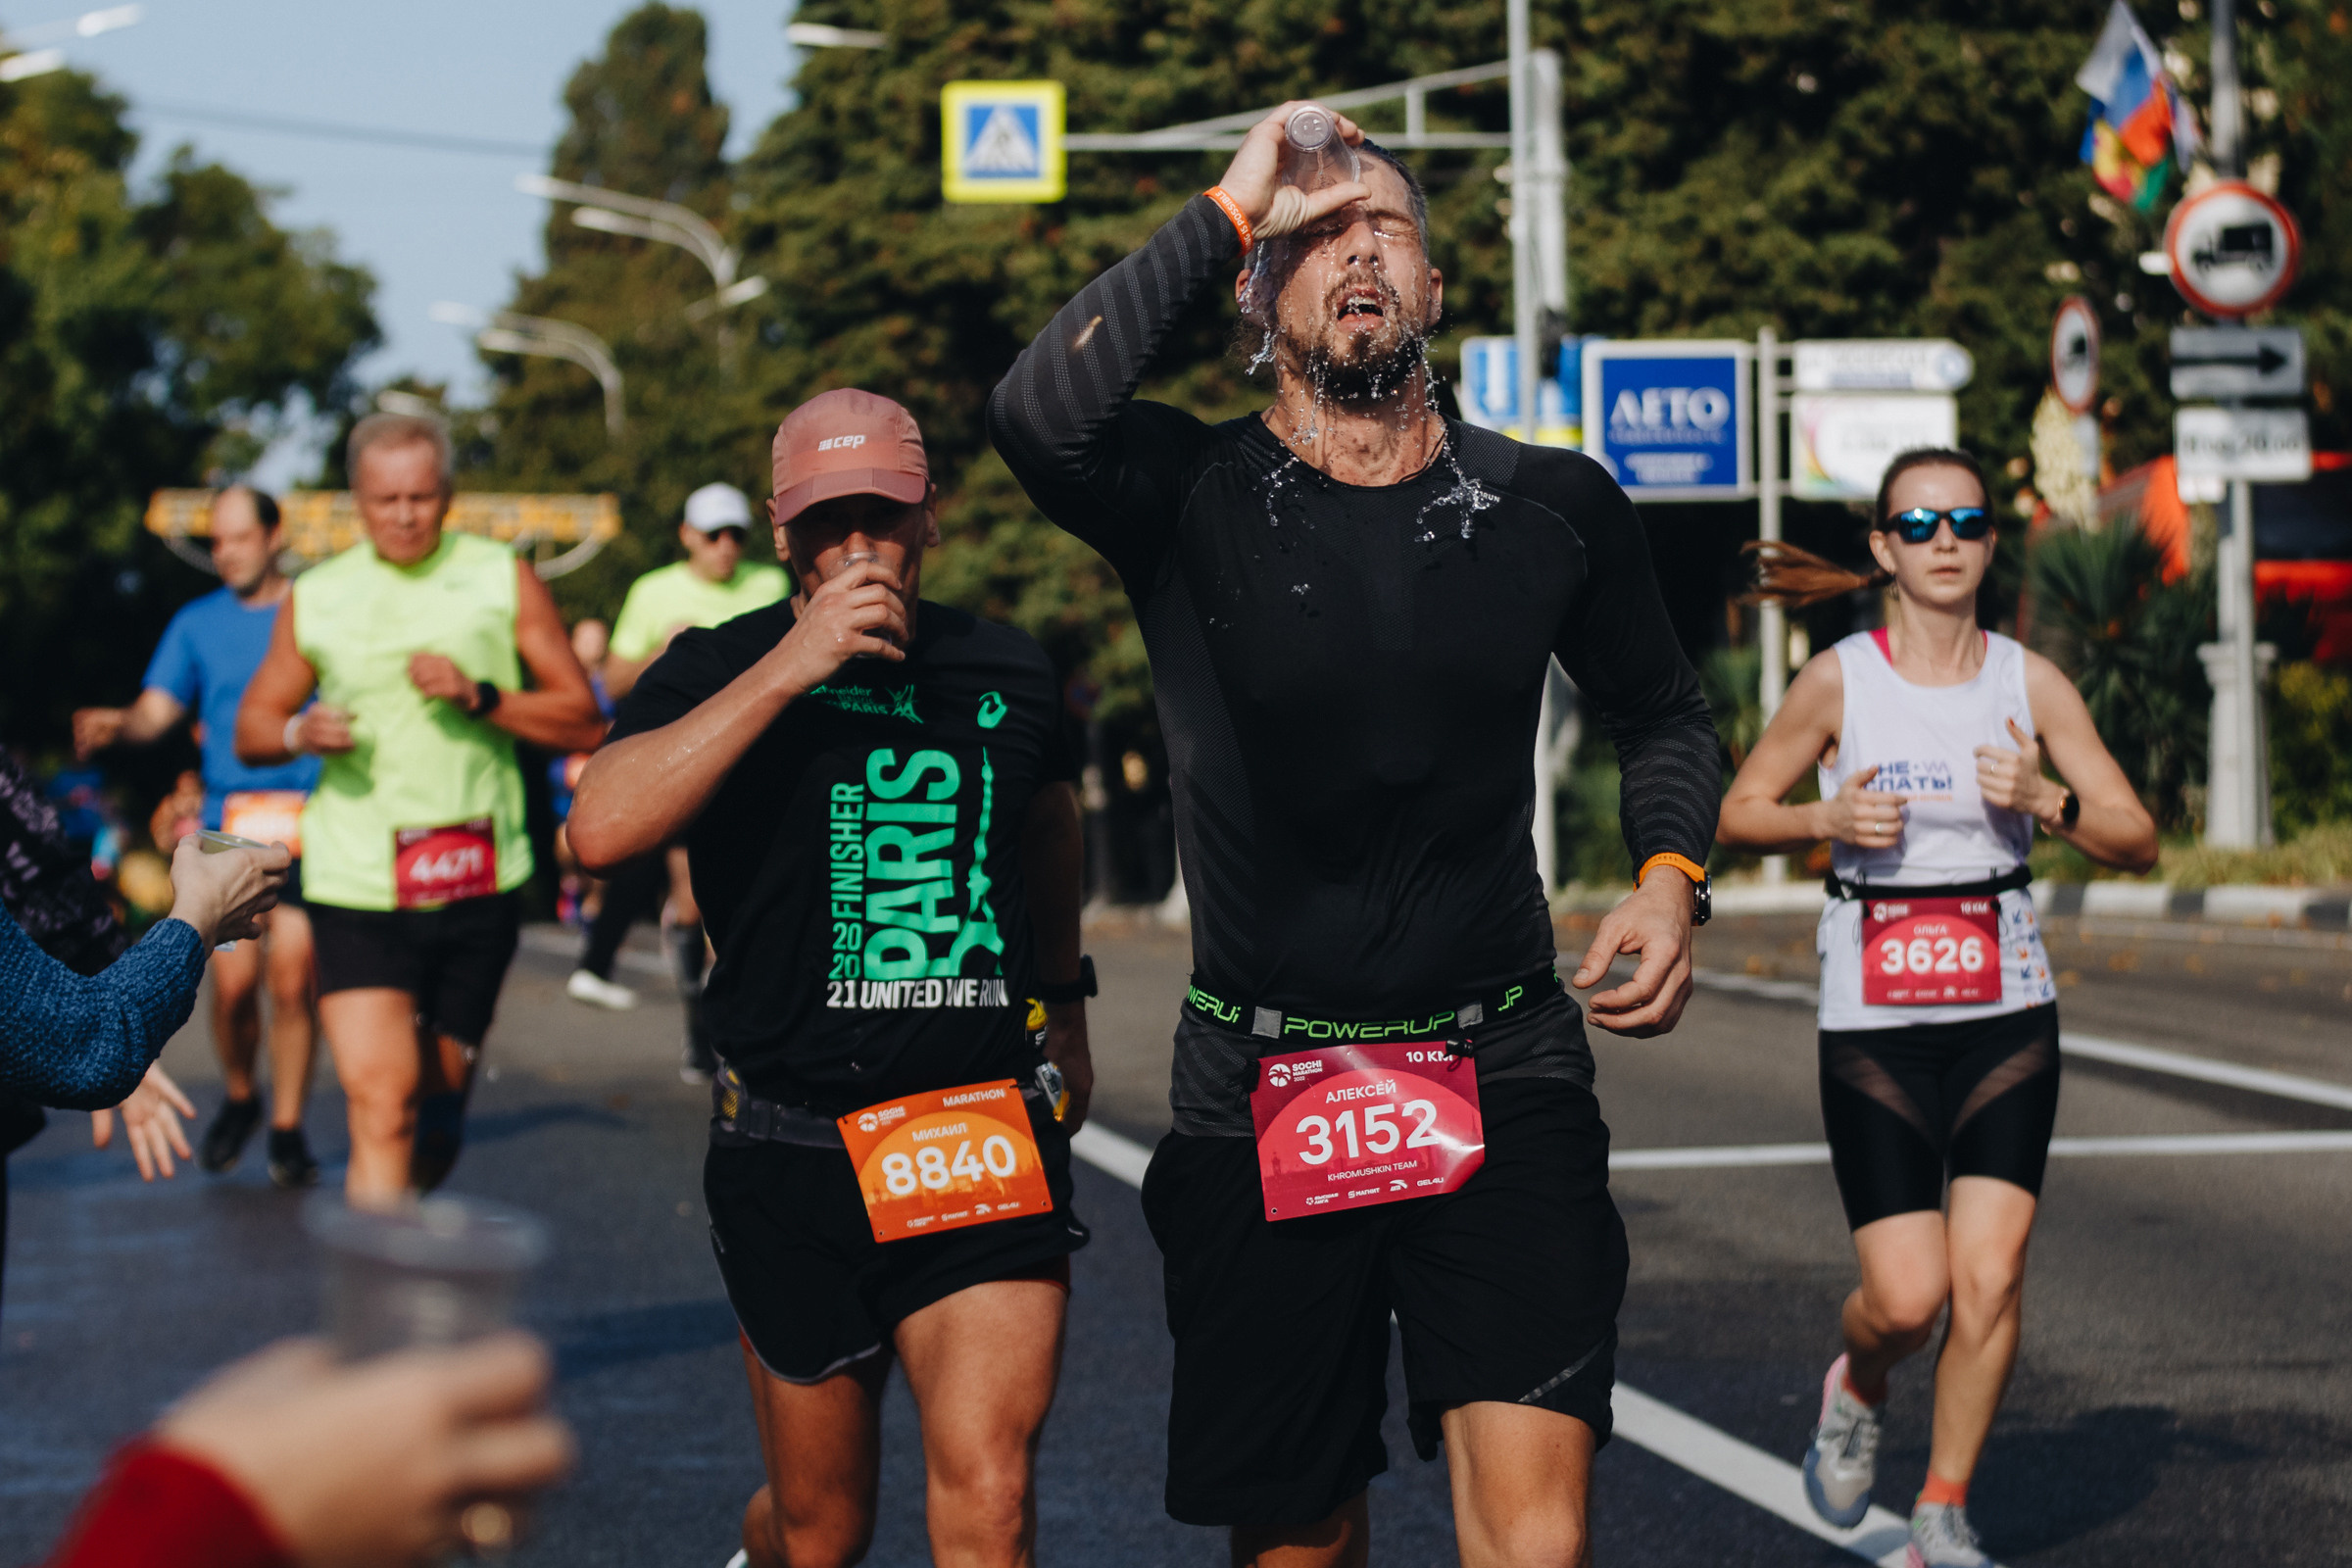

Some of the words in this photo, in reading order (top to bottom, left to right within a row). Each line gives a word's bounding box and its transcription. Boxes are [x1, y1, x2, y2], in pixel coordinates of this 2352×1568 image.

[1215, 190, 1245, 226] POSSIBLE
[832, 434, 866, 449] cep
[1476, 489, 1500, 503] RUN
[830, 783, 864, 918] FINISHER
[864, 748, 960, 980] PARIS
[1913, 924, 1948, 936] ОЛЬГА
[1880, 936, 1984, 976] 3626
[826, 981, 857, 1008] 21
[860, 979, 944, 1009] UNITED
[945, 978, 979, 1007] WE
[979, 978, 1009, 1007] RUN
[1284, 1010, 1455, 1039] POWERUP
[1292, 1059, 1322, 1072] SOCHI
[1405, 1051, 1424, 1062] 10
[1427, 1051, 1453, 1062] KM
[942, 1088, 1006, 1107] MARATHON
[911, 1122, 967, 1143] МИХАИЛ
[1296, 1099, 1441, 1165] 3152
[881, 1135, 1016, 1196] 8840
[1327, 1164, 1392, 1182] KHROMUSHKIN
[1392, 1160, 1418, 1171] TEAM
